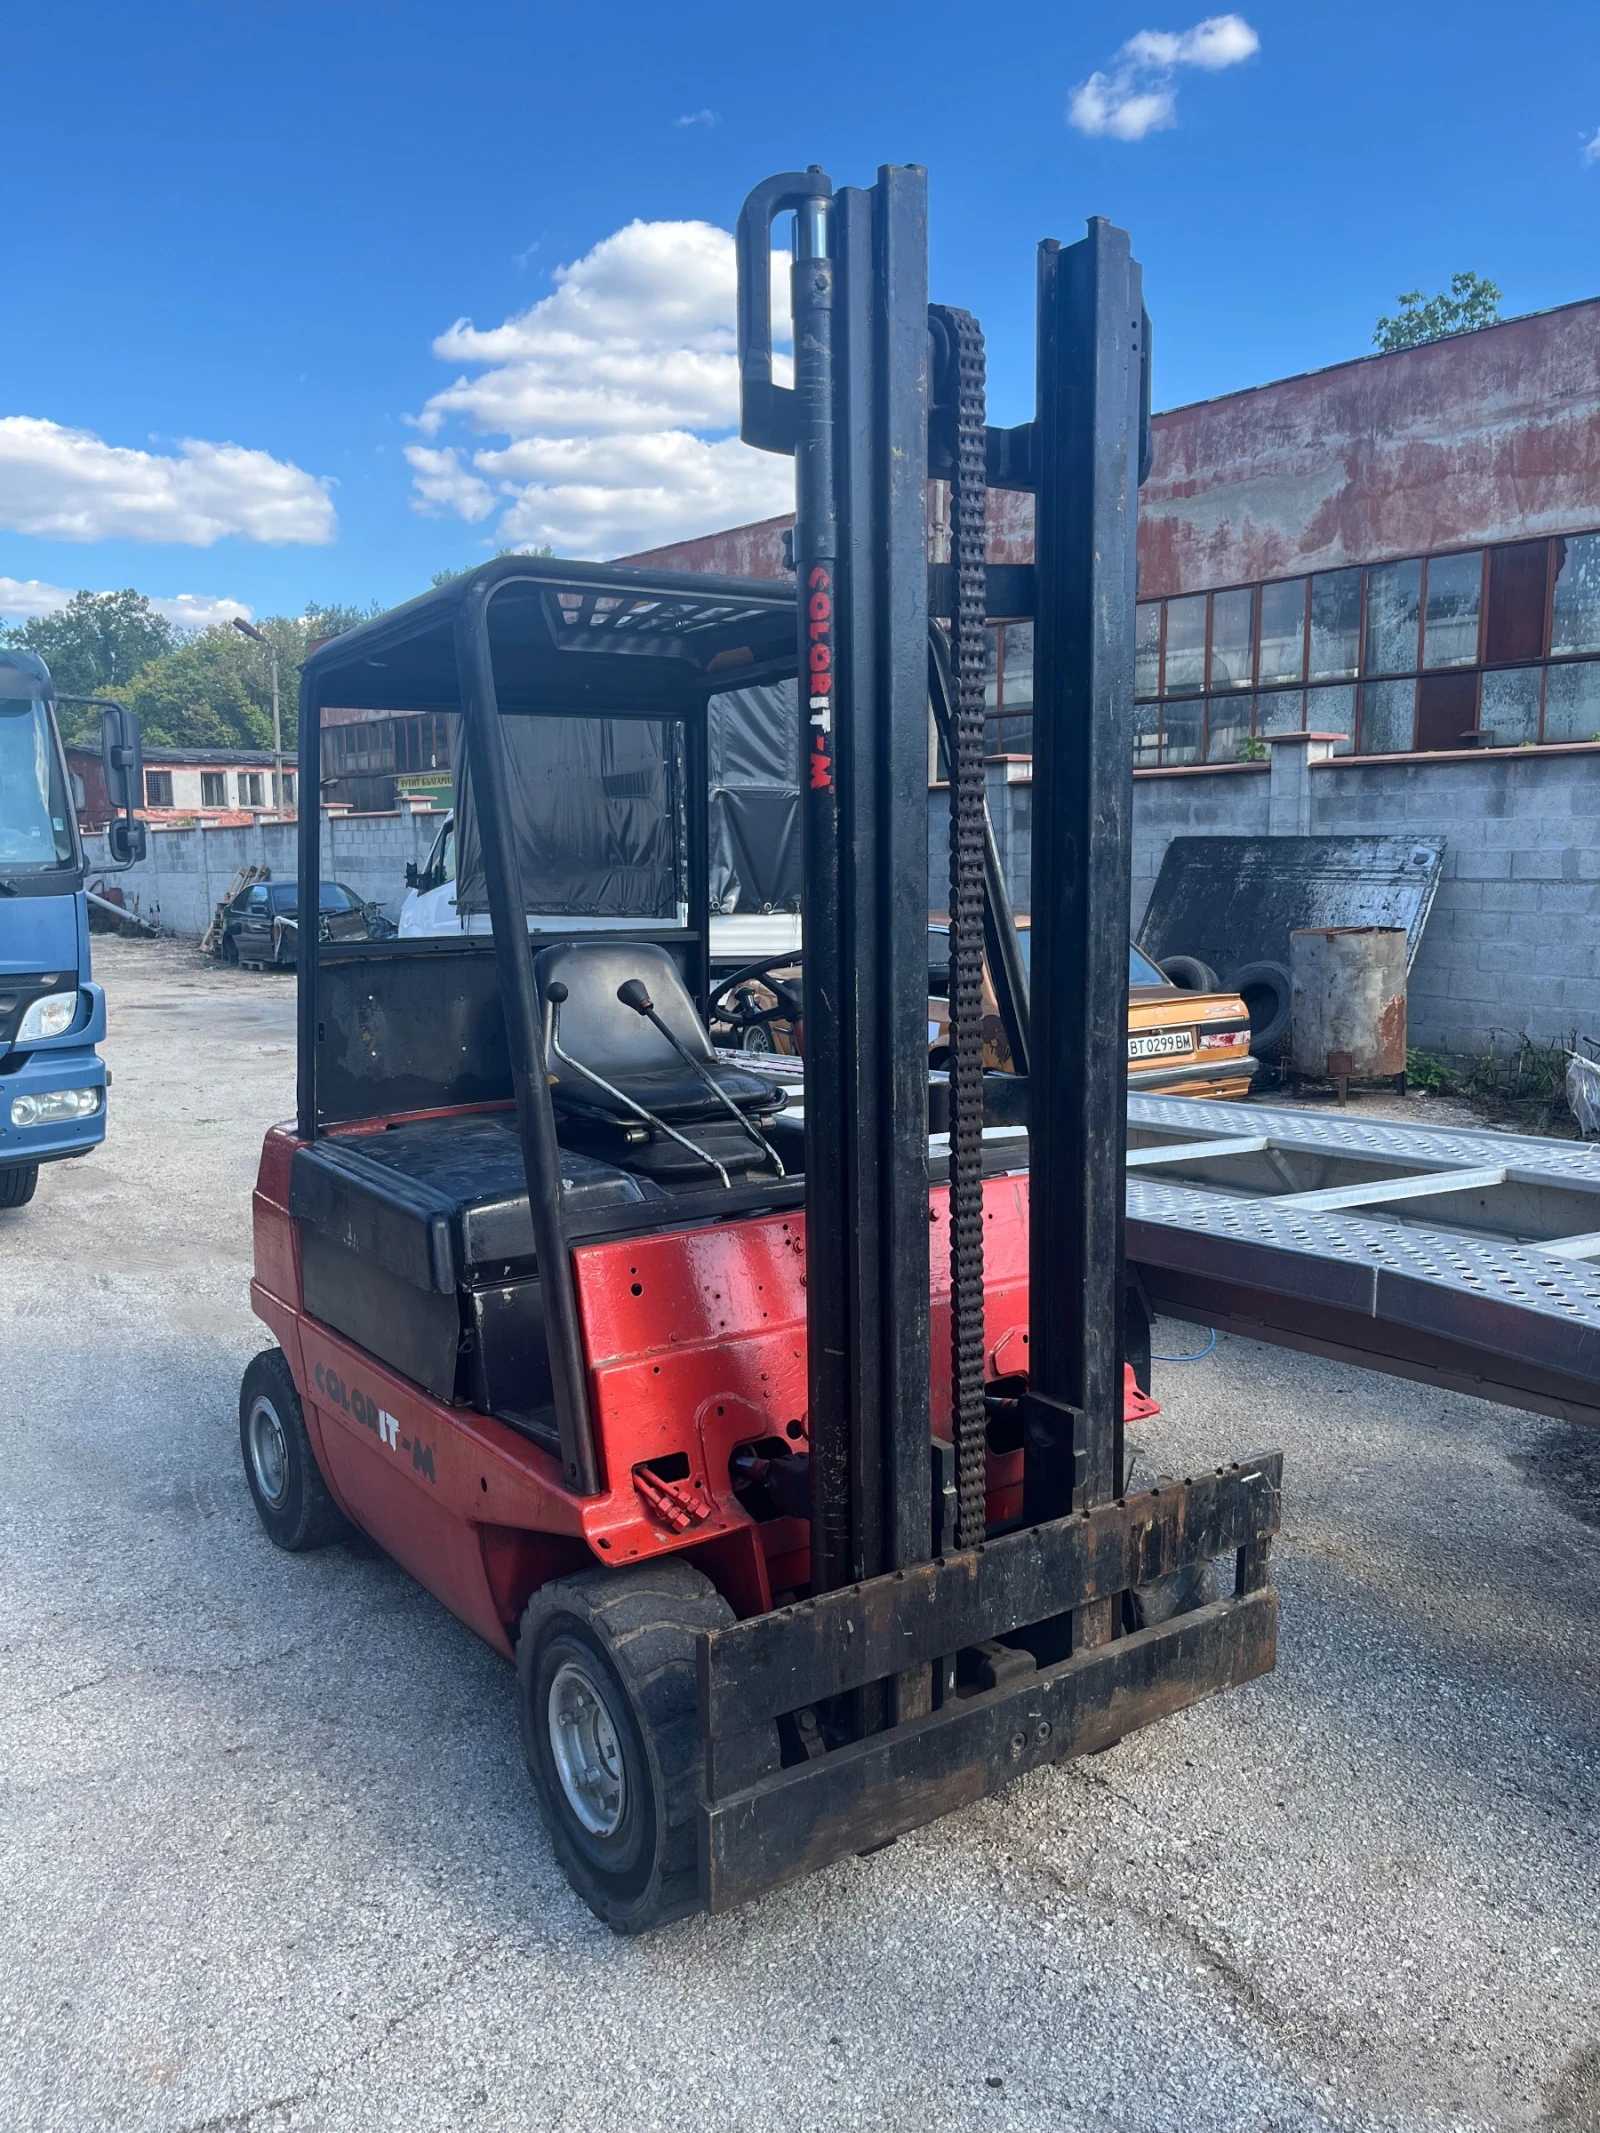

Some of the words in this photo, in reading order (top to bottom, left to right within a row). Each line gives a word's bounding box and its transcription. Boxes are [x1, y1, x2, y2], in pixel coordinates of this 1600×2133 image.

[1130, 1039, 1145, 1055] BT
[1147, 1036, 1174, 1053] 0299
[1176, 1034, 1191, 1049] BM
